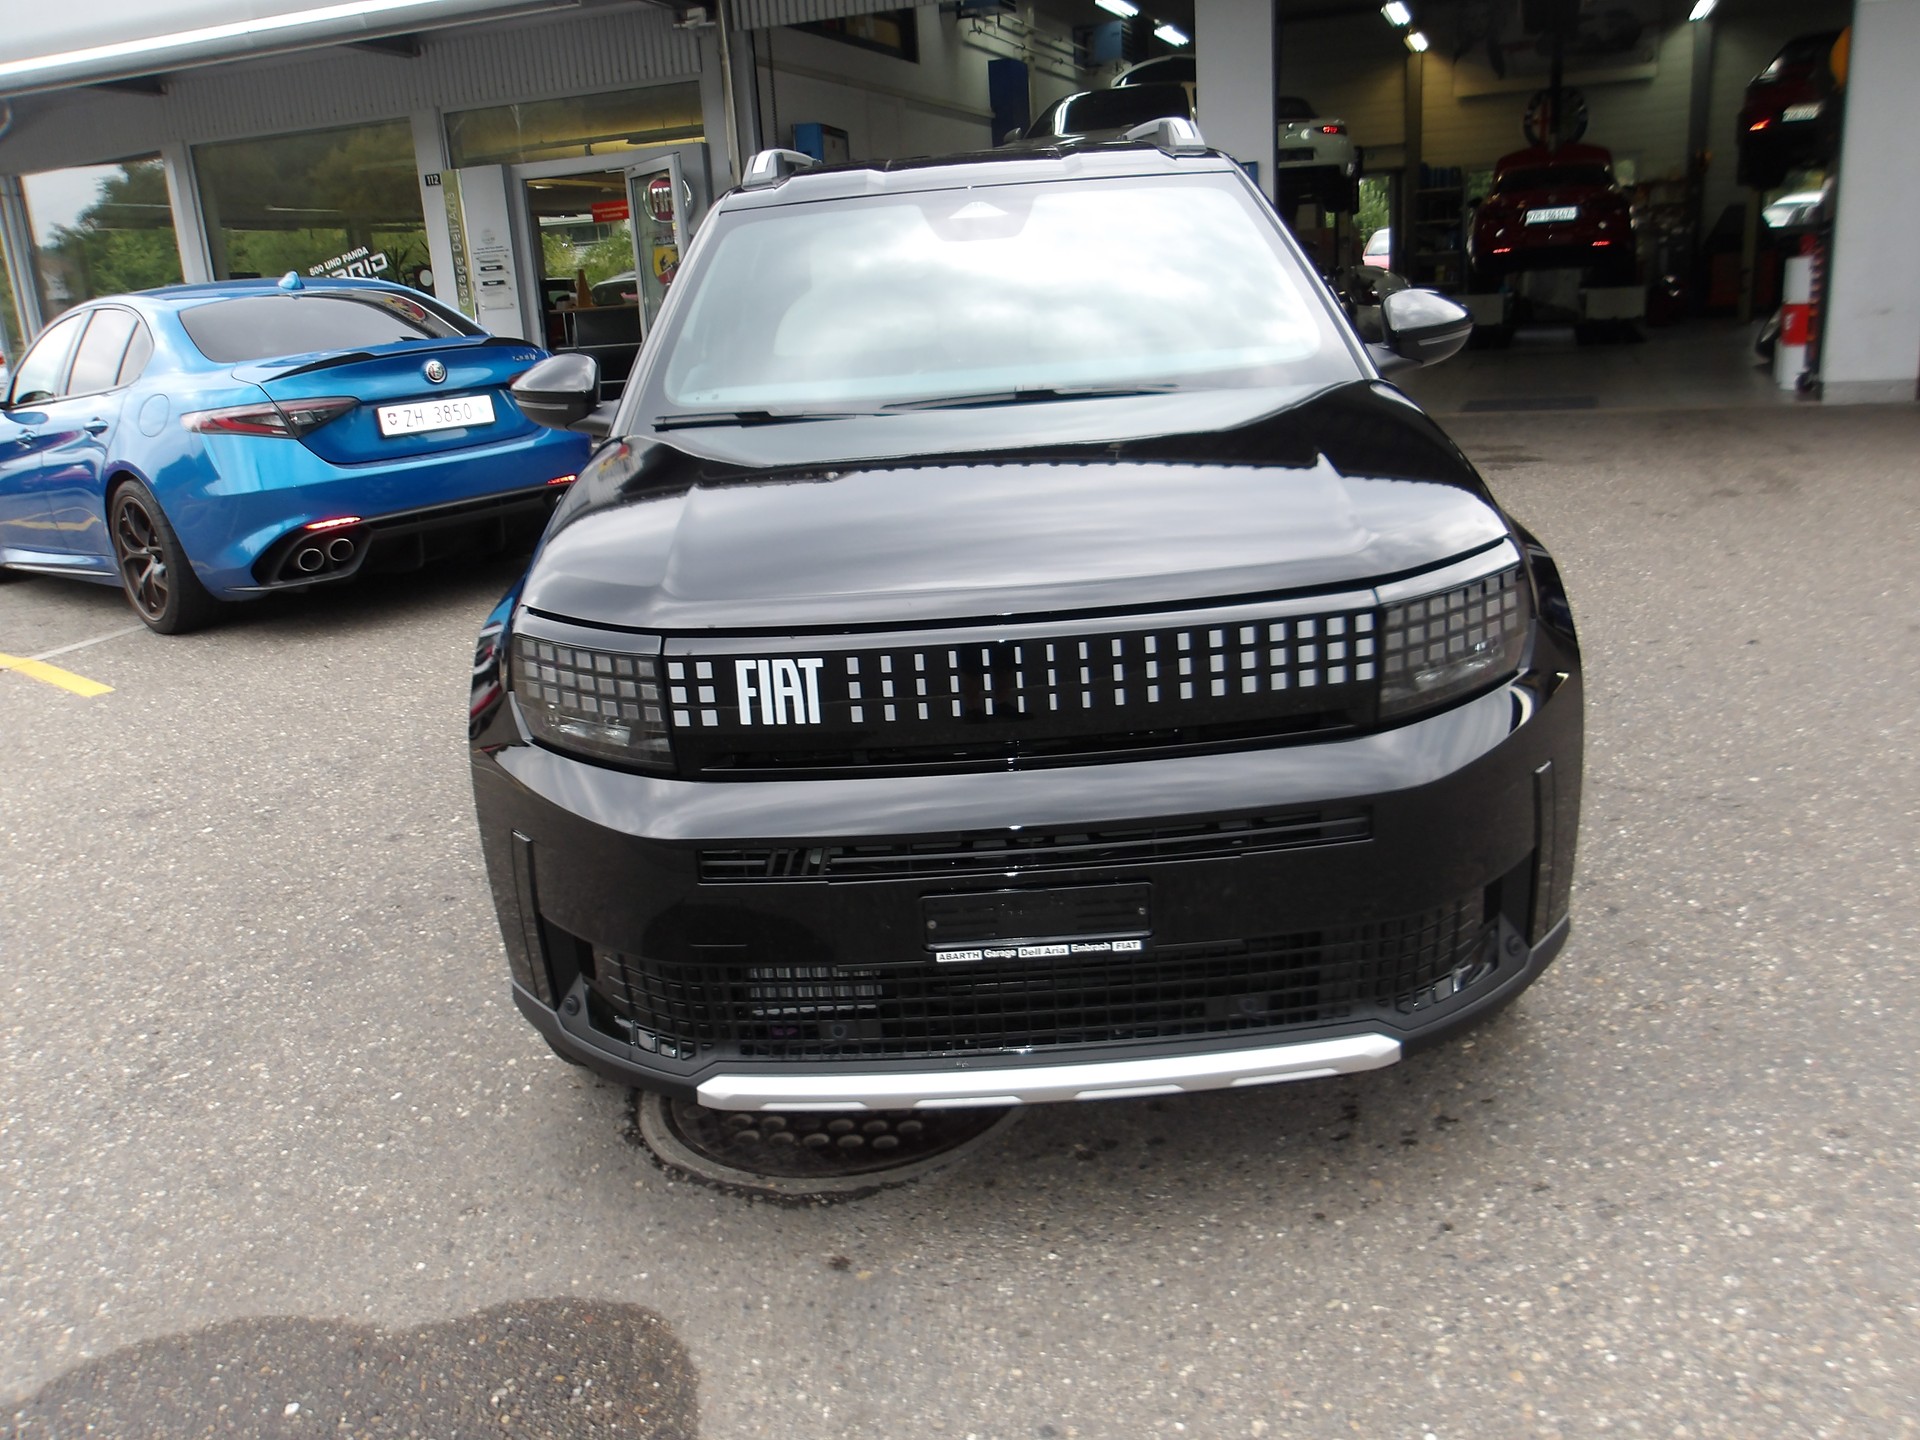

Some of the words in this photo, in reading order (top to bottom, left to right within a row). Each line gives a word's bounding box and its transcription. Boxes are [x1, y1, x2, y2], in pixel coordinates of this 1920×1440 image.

[426, 175, 440, 186] 112
[450, 223, 463, 252] Dell
[324, 257, 342, 270] UND
[342, 246, 369, 263] PANDA
[456, 257, 469, 307] Garage
[403, 409, 424, 428] ZH
[433, 402, 473, 424] 3850
[734, 657, 824, 726] FIAT
[939, 951, 981, 961] ABARTH
[983, 948, 1018, 959] Garage
[1021, 947, 1042, 956] Dell
[1044, 946, 1066, 955] Aria
[1115, 941, 1139, 950] FIAT
